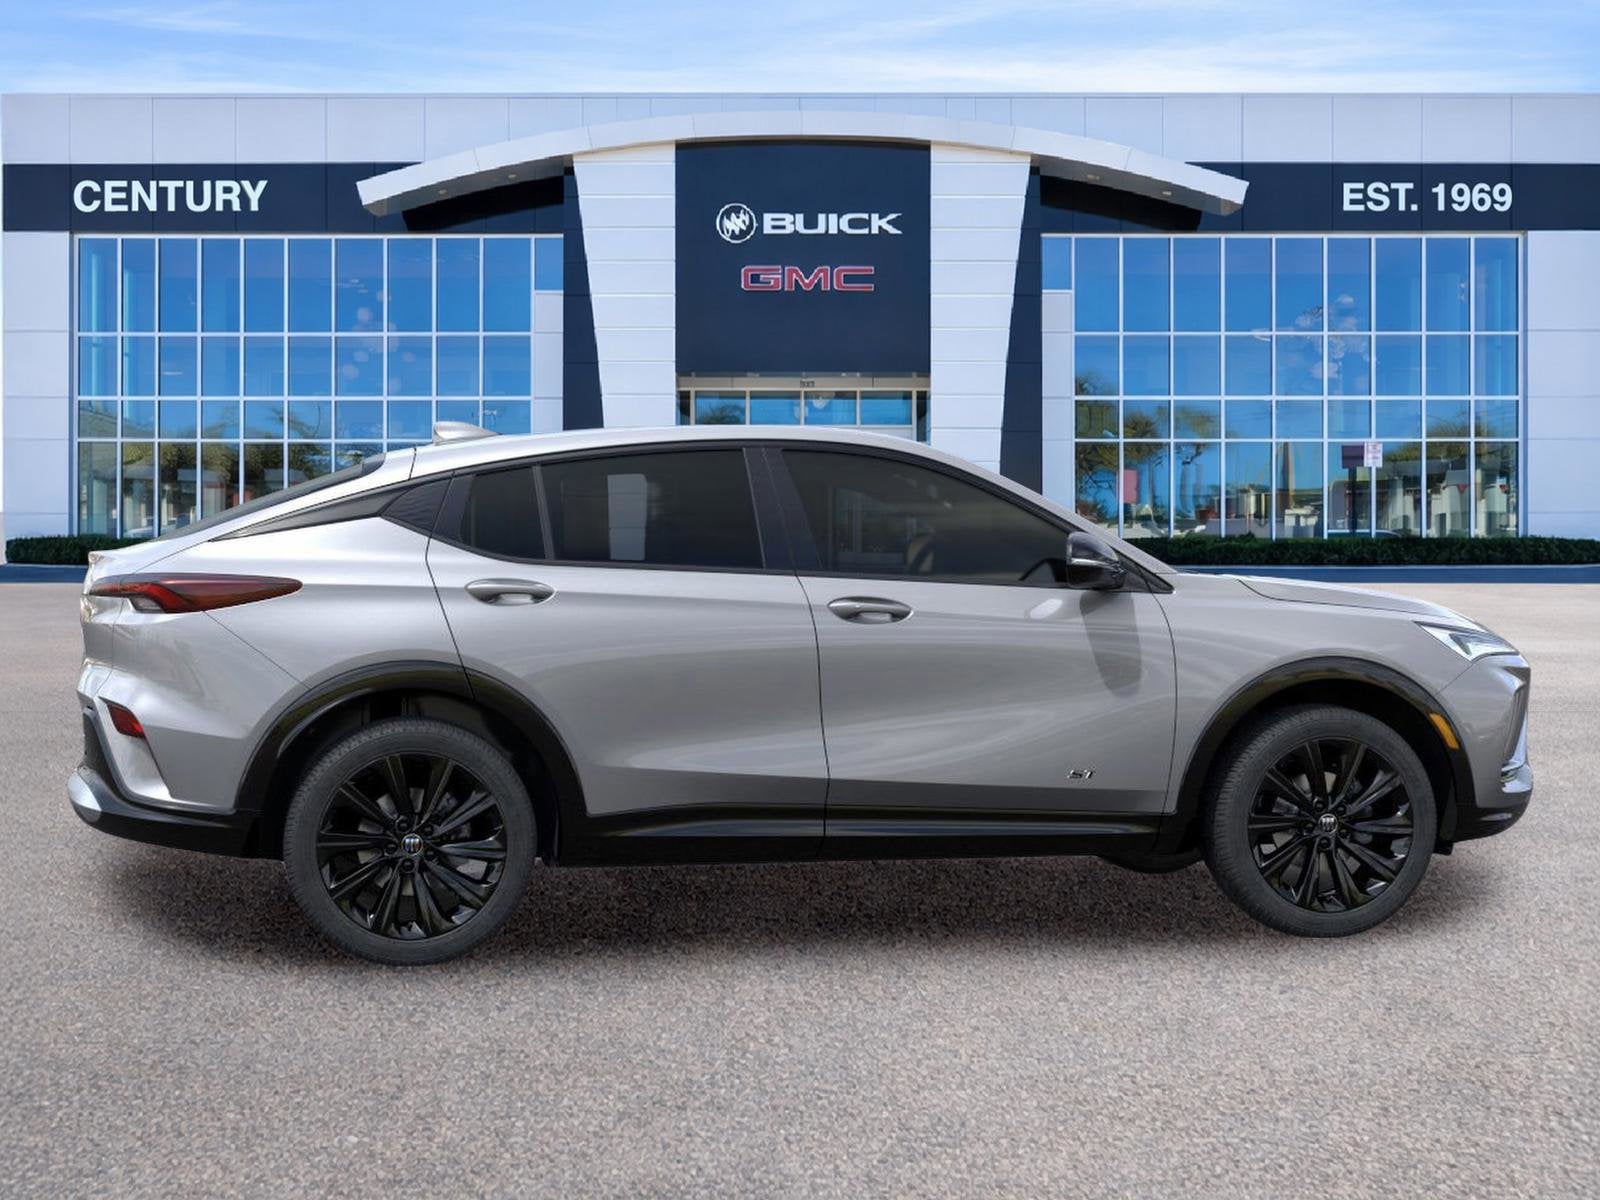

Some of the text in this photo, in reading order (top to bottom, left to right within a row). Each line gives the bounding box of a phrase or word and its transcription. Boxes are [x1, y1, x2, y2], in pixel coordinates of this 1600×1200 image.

[73, 179, 269, 213] CENTURY
[1342, 181, 1513, 213] EST. 1969
[762, 212, 903, 236] BUICK
[740, 265, 876, 293] GMC
